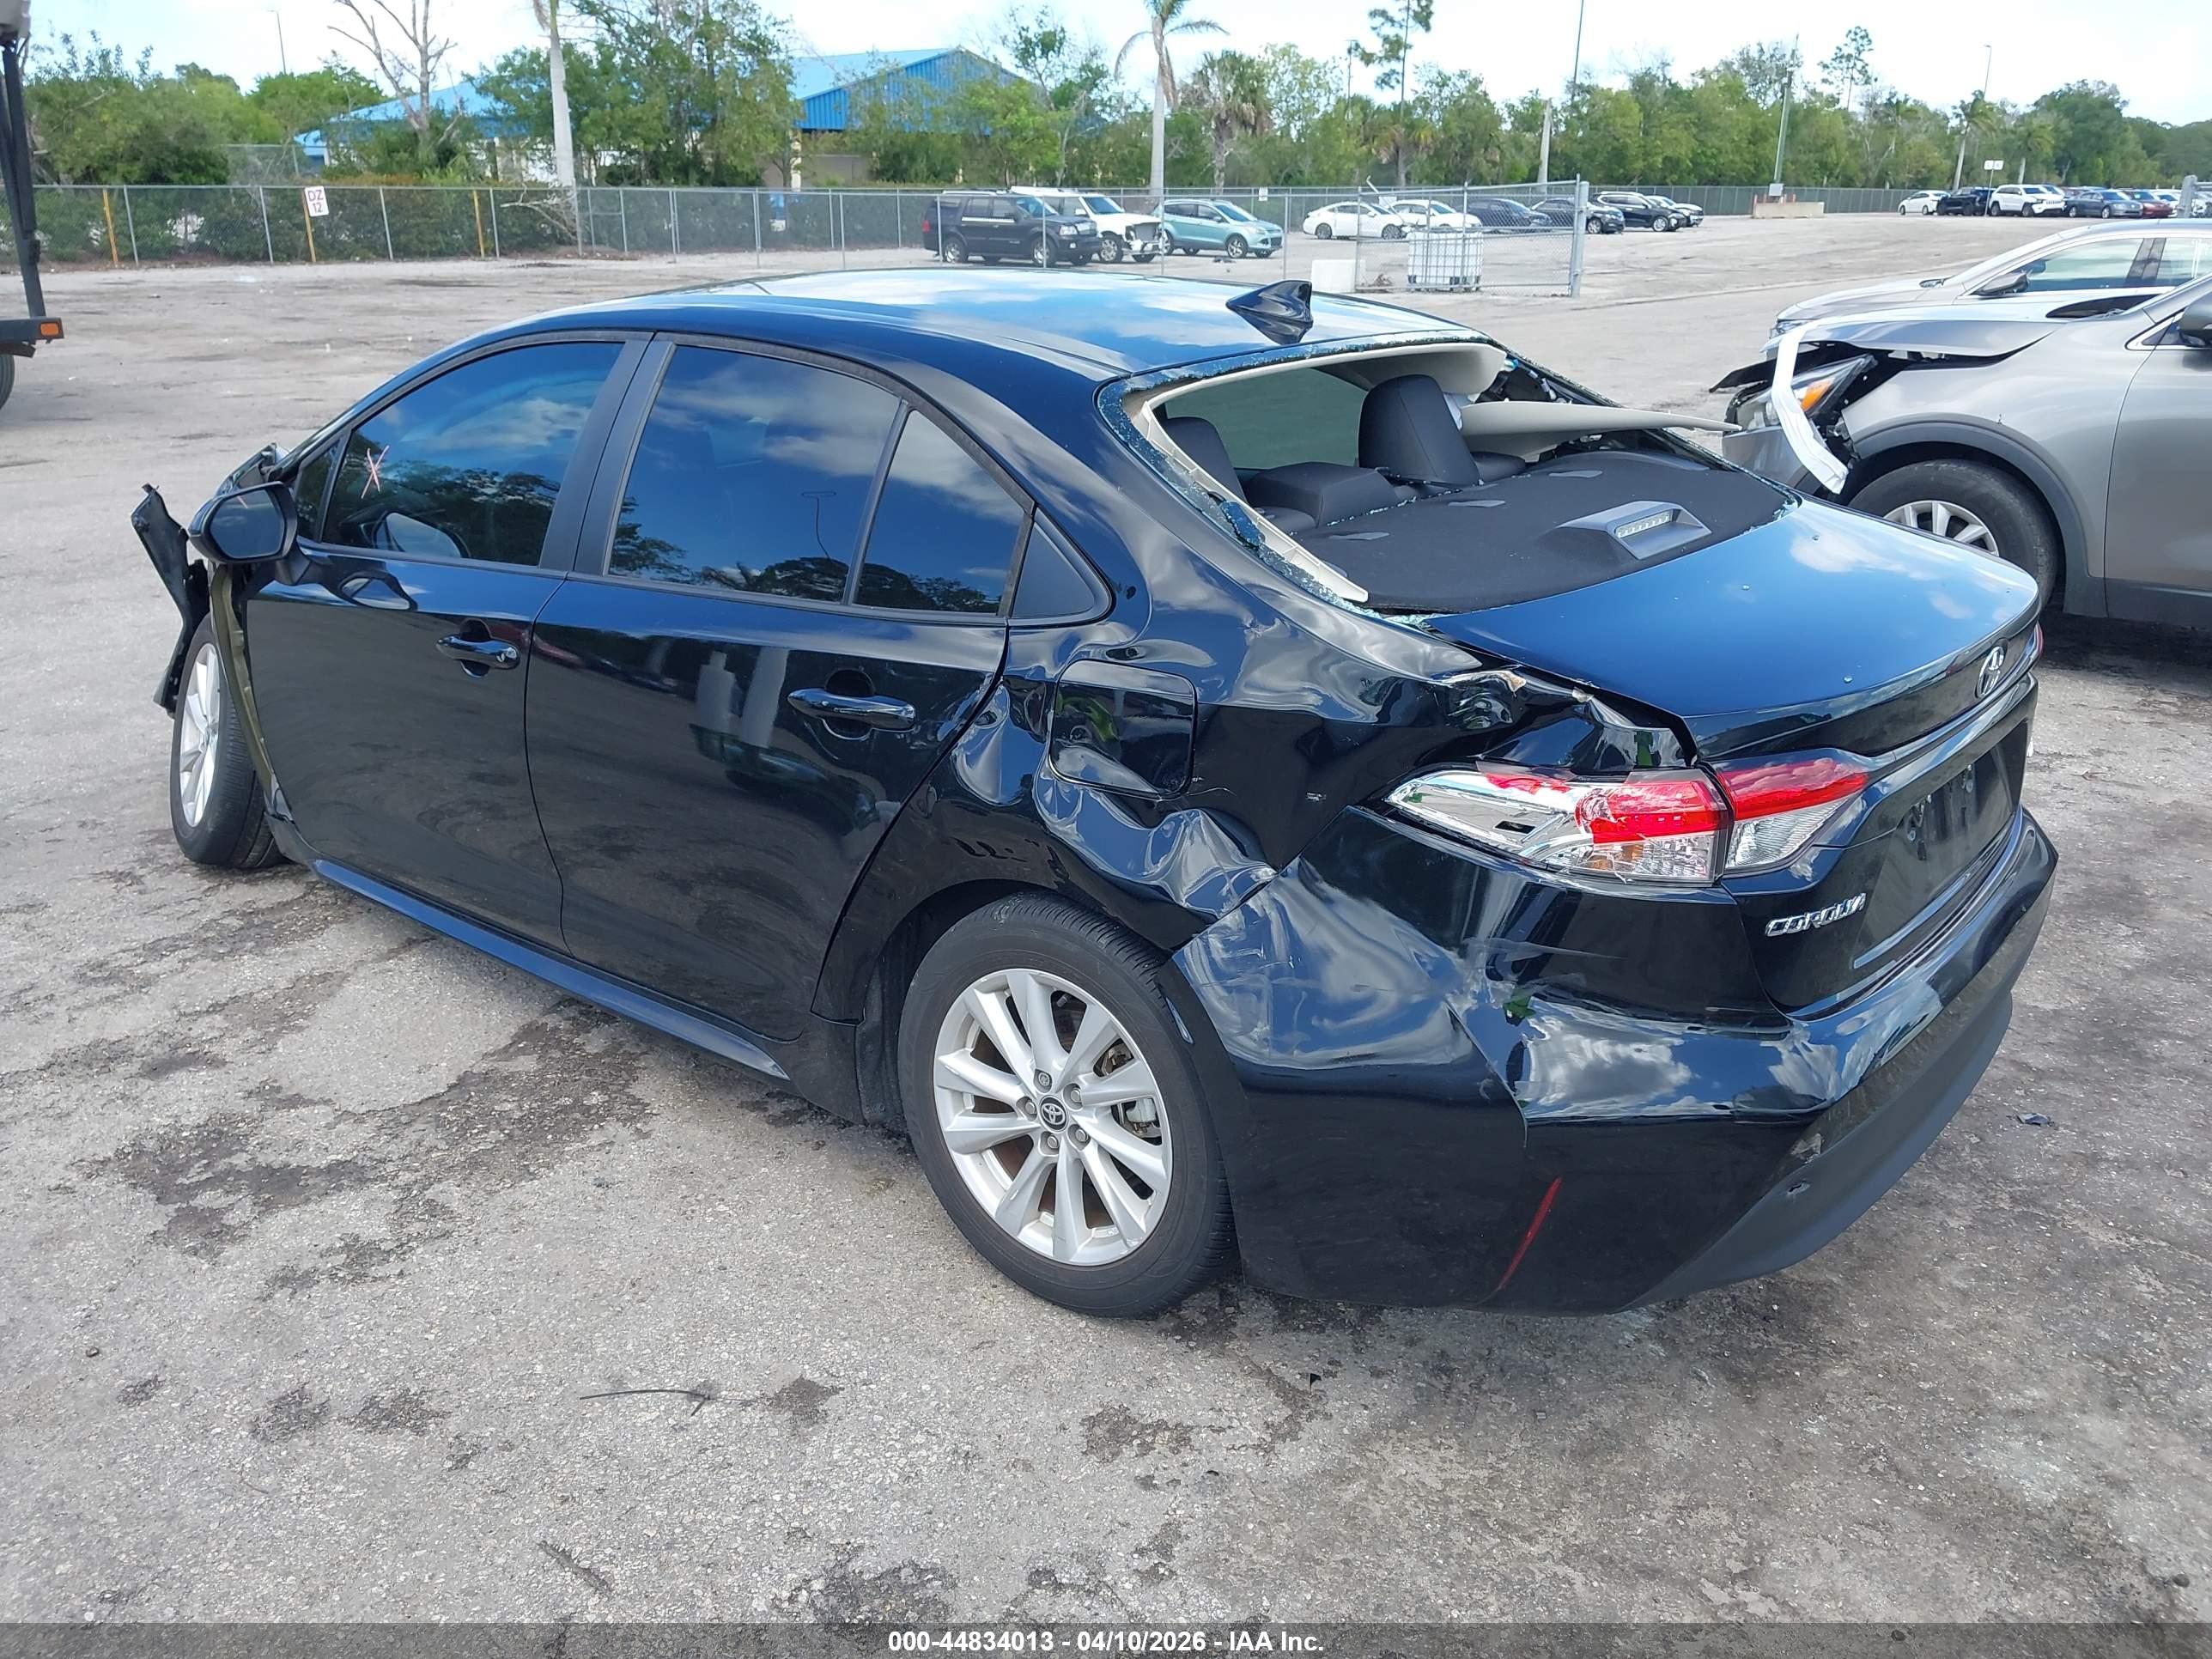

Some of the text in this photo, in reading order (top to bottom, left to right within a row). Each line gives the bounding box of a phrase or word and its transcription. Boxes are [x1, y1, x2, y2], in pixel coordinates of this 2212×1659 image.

[308, 190, 324, 202] DZ
[312, 203, 323, 213] 12
[1765, 893, 1866, 936] COROLLA
